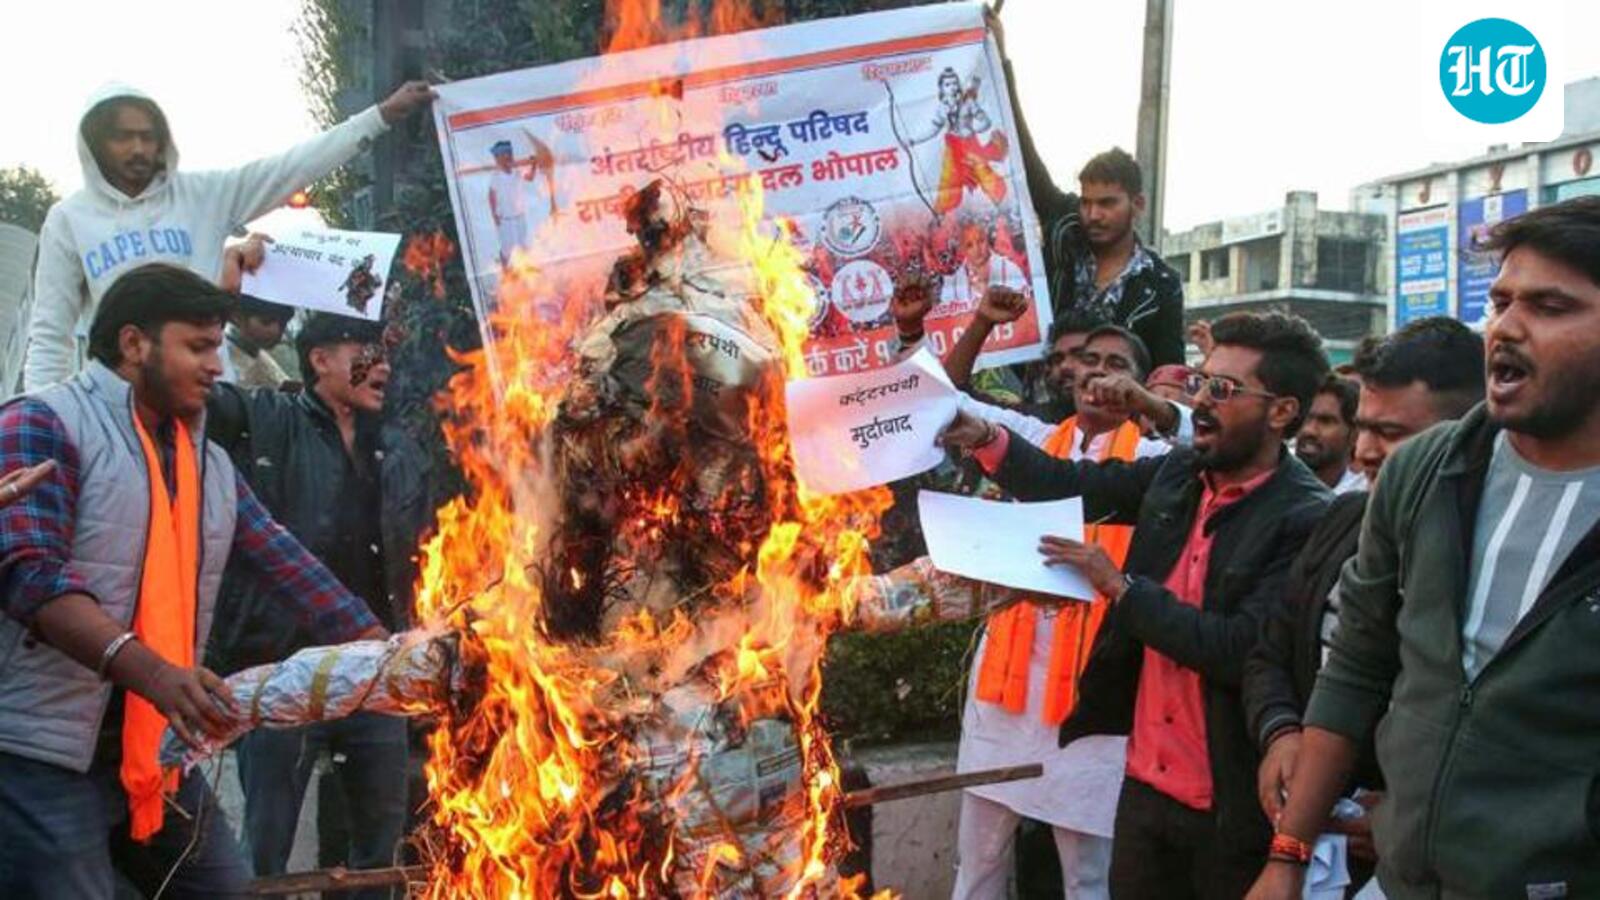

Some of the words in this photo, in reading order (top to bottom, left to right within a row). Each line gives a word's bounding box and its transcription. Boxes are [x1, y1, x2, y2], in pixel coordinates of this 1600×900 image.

[722, 122, 789, 156] हिन्दू
[787, 109, 868, 143] परिषद
[757, 163, 804, 191] दल
[811, 151, 899, 181] भोपाल
[85, 230, 146, 279] CAPE
[148, 227, 193, 257] COD
